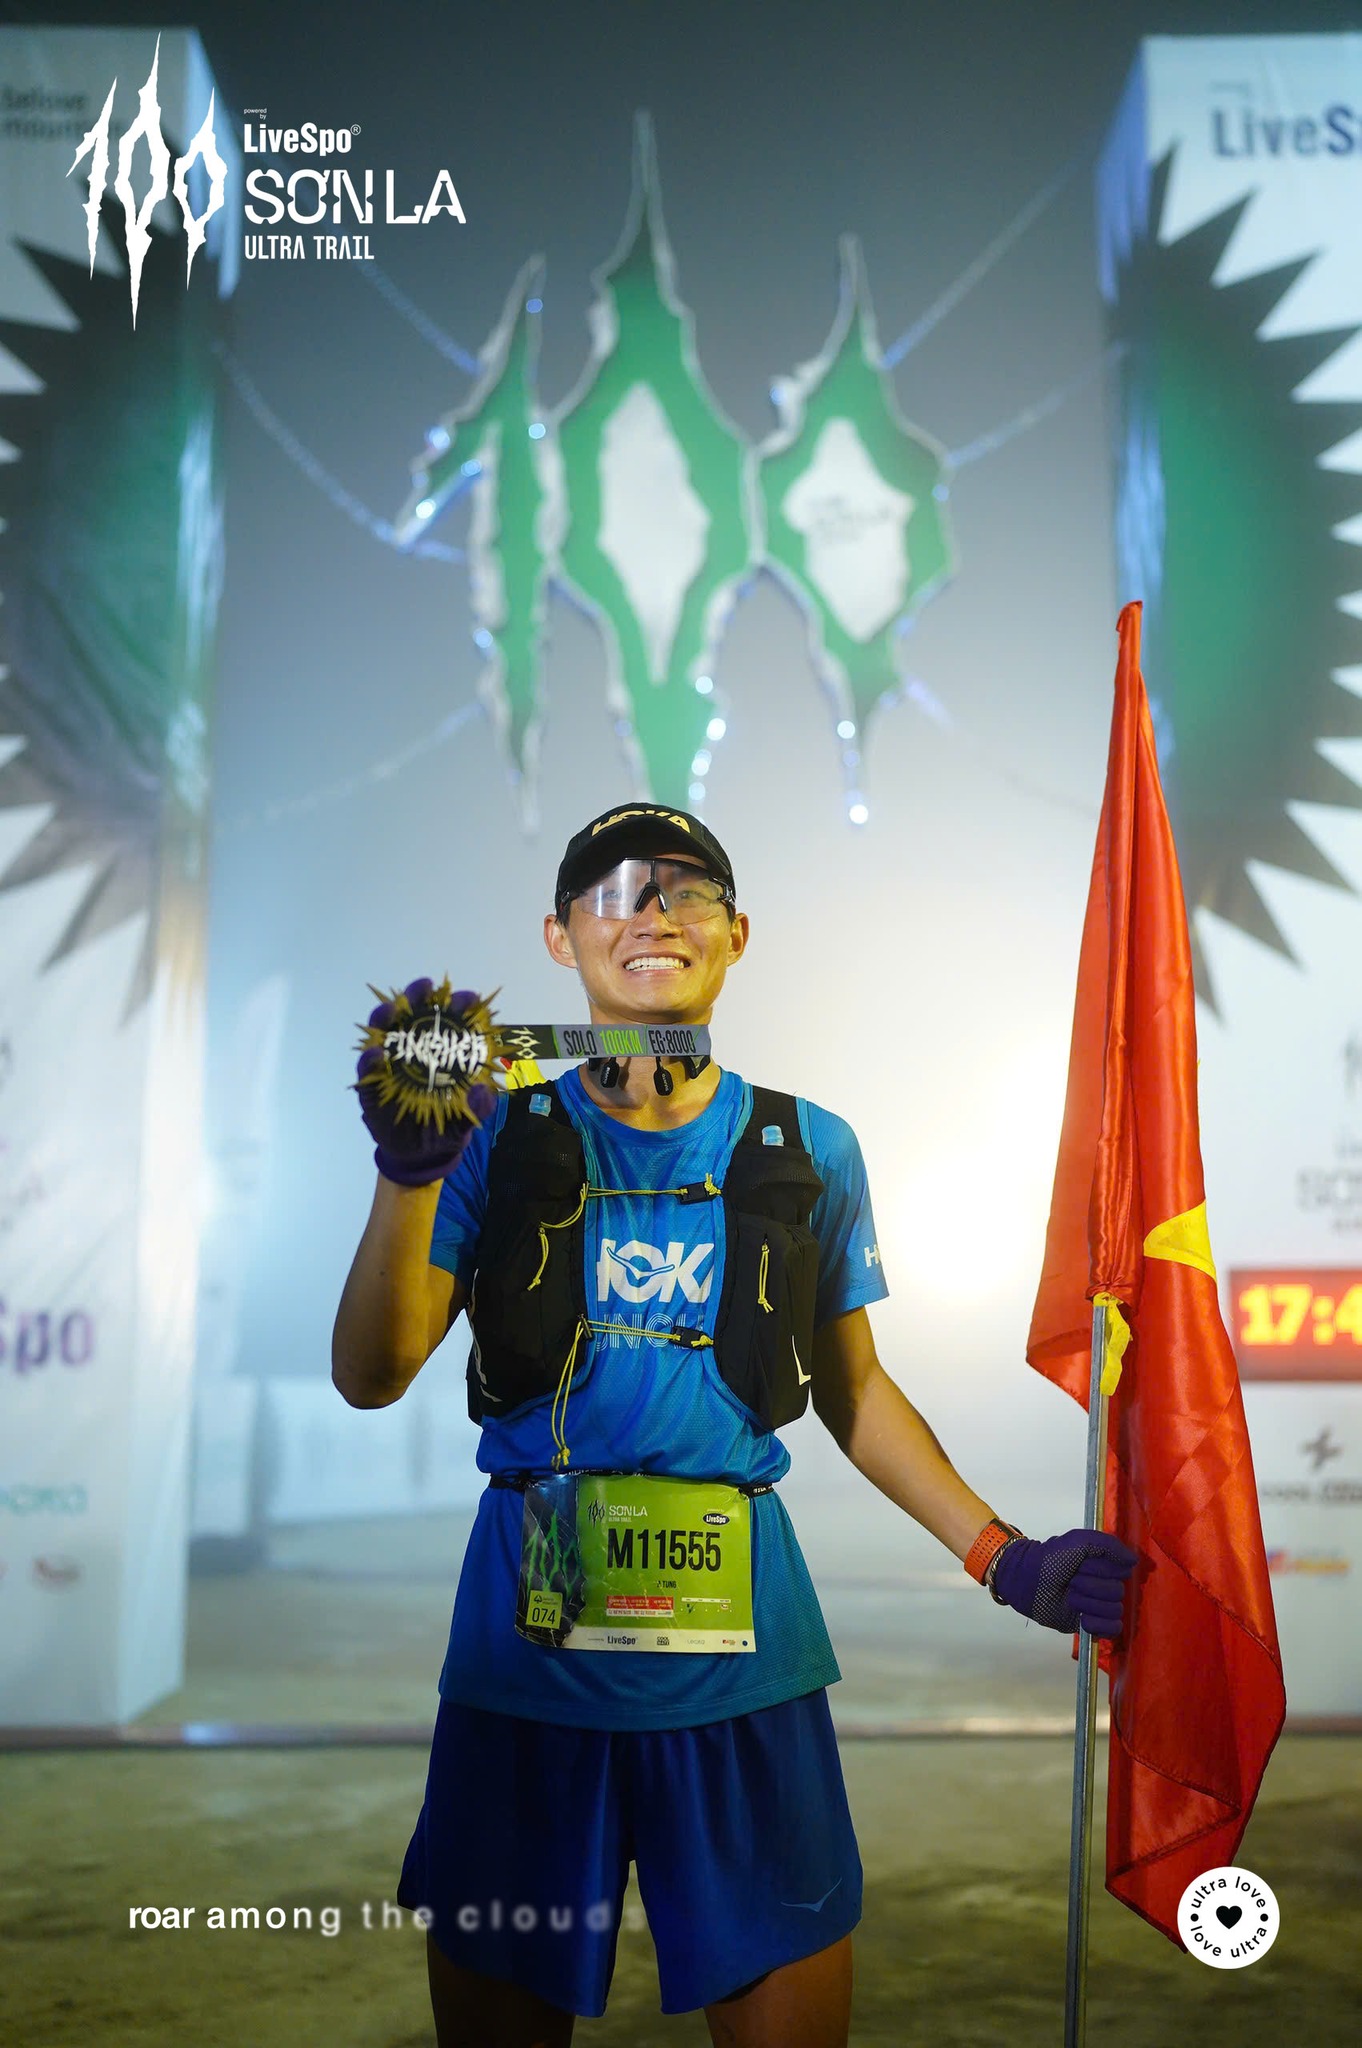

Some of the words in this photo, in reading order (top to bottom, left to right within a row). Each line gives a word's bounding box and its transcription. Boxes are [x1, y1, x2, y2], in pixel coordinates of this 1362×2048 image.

[1210, 105, 1362, 157] LiveS
[563, 1029, 598, 1056] SOLO
[599, 1029, 644, 1056] 100KM
[648, 1029, 696, 1055] EG:8000
[0, 1297, 95, 1376] po
[607, 1528, 721, 1572] M11555
[532, 1607, 556, 1625] 074
